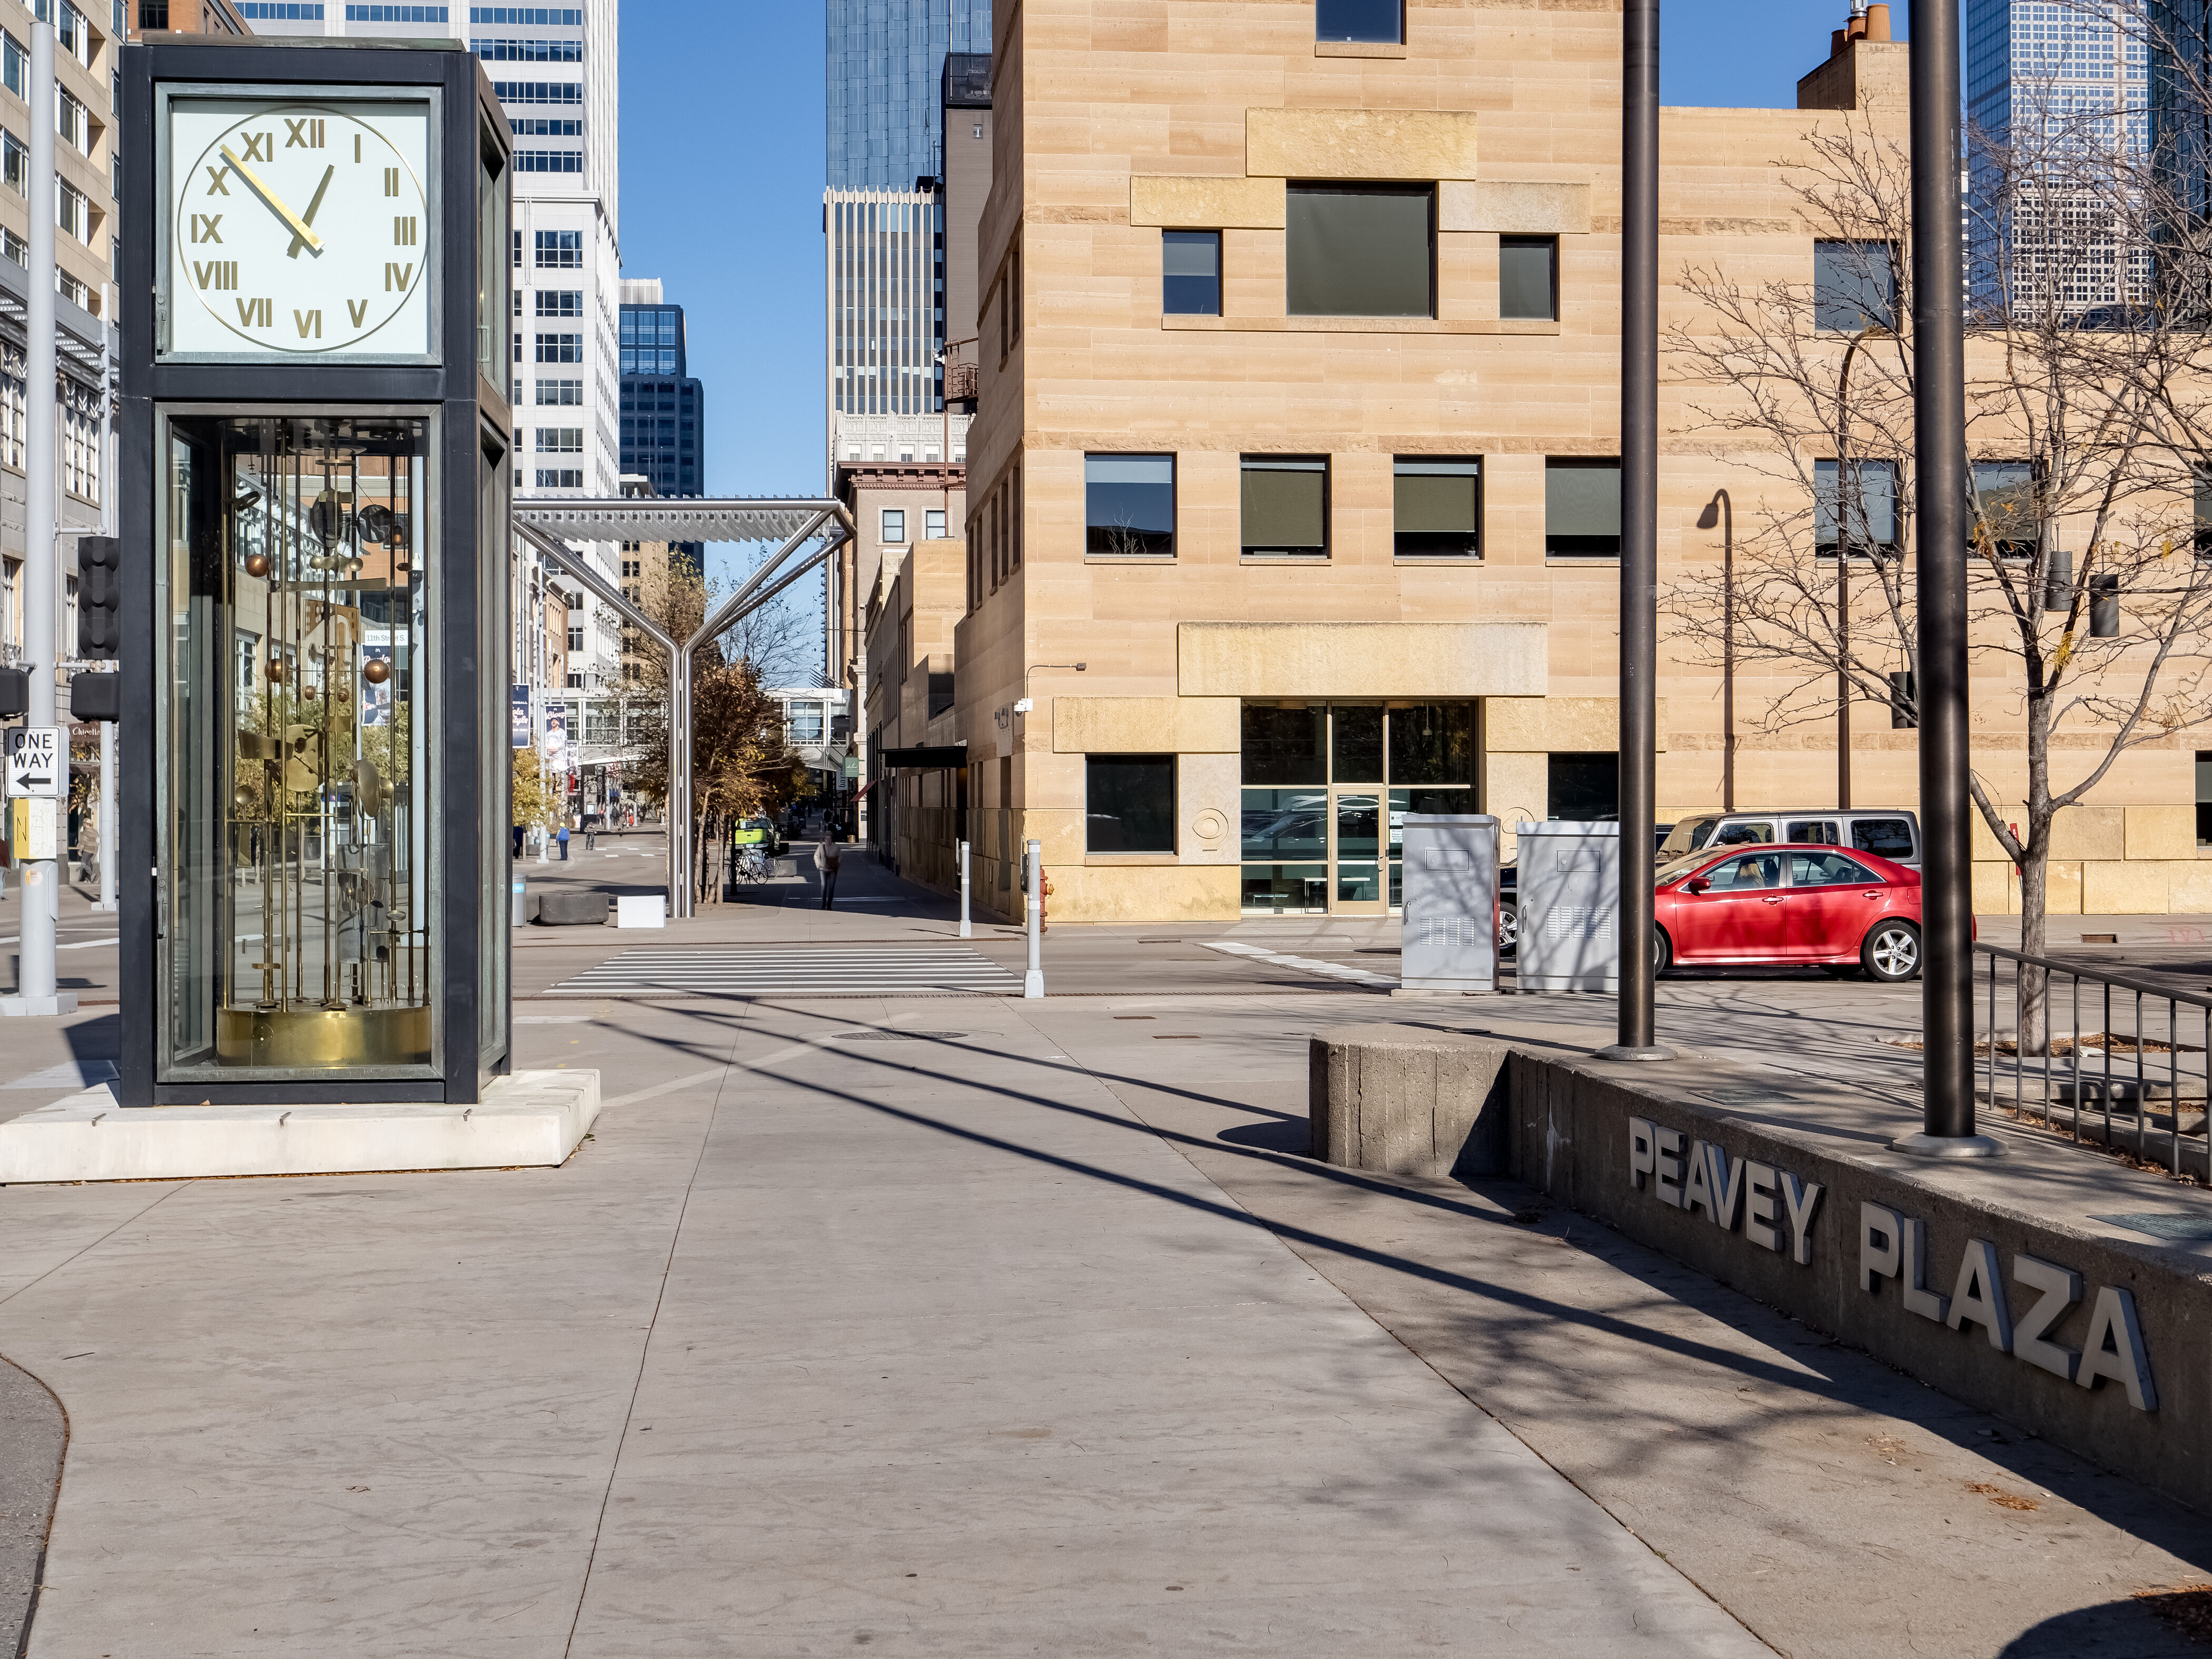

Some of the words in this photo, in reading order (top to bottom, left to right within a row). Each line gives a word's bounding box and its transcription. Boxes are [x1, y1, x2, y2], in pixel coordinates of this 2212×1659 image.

[241, 132, 273, 162] XI
[284, 118, 325, 148] XII
[354, 134, 361, 163] I
[206, 166, 231, 195] X
[384, 167, 399, 196] II
[191, 214, 224, 243] IX
[394, 216, 417, 245] III
[193, 261, 238, 290] VIII
[384, 262, 413, 292] IV
[235, 298, 272, 327] VII
[293, 309, 322, 339] VI
[347, 299, 369, 328] V
[15, 733, 52, 749] ONE
[72, 726, 101, 737] Chipotle
[13, 753, 53, 768] WAY
[1630, 1116, 1826, 1264] PEAVEY
[1860, 1201, 2158, 1411] PLAZA
